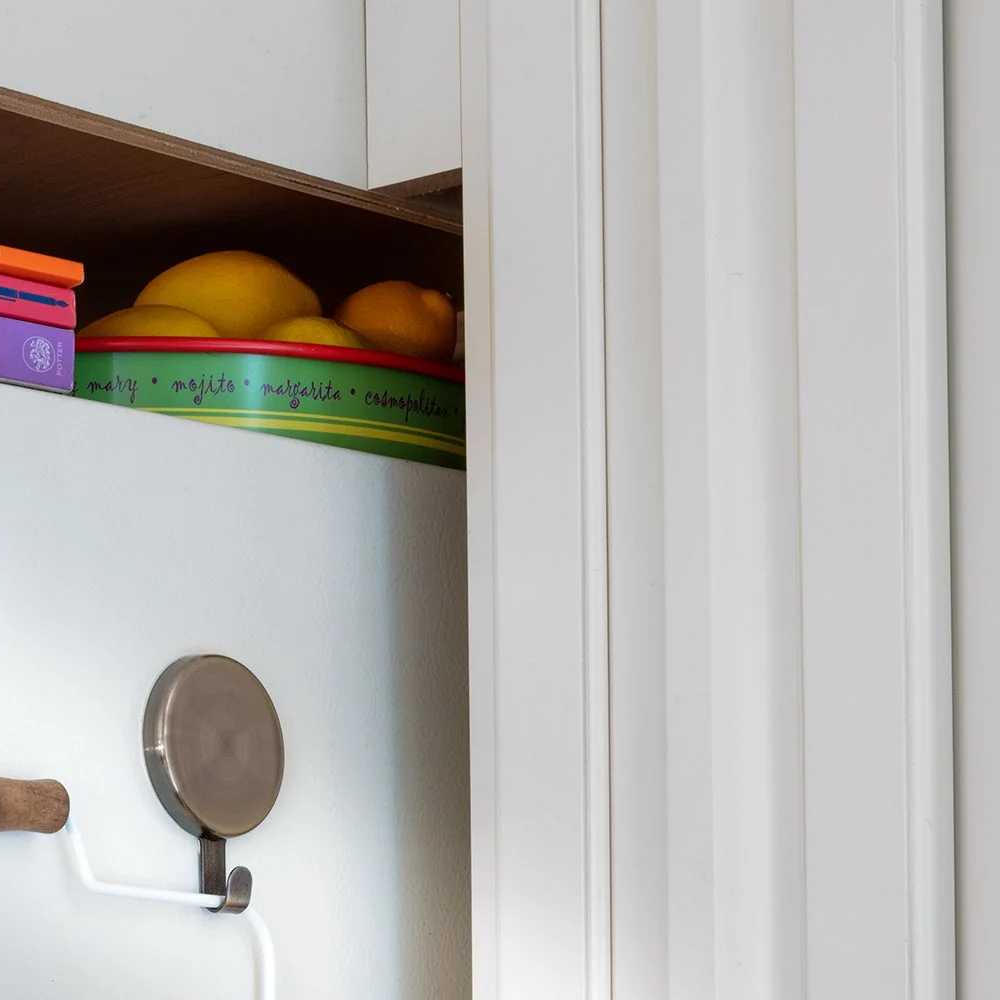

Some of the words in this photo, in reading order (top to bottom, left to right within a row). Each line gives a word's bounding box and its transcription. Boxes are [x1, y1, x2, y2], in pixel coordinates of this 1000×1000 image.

[87, 374, 138, 404] mary
[171, 372, 236, 406] mojito
[259, 379, 342, 410] margarita
